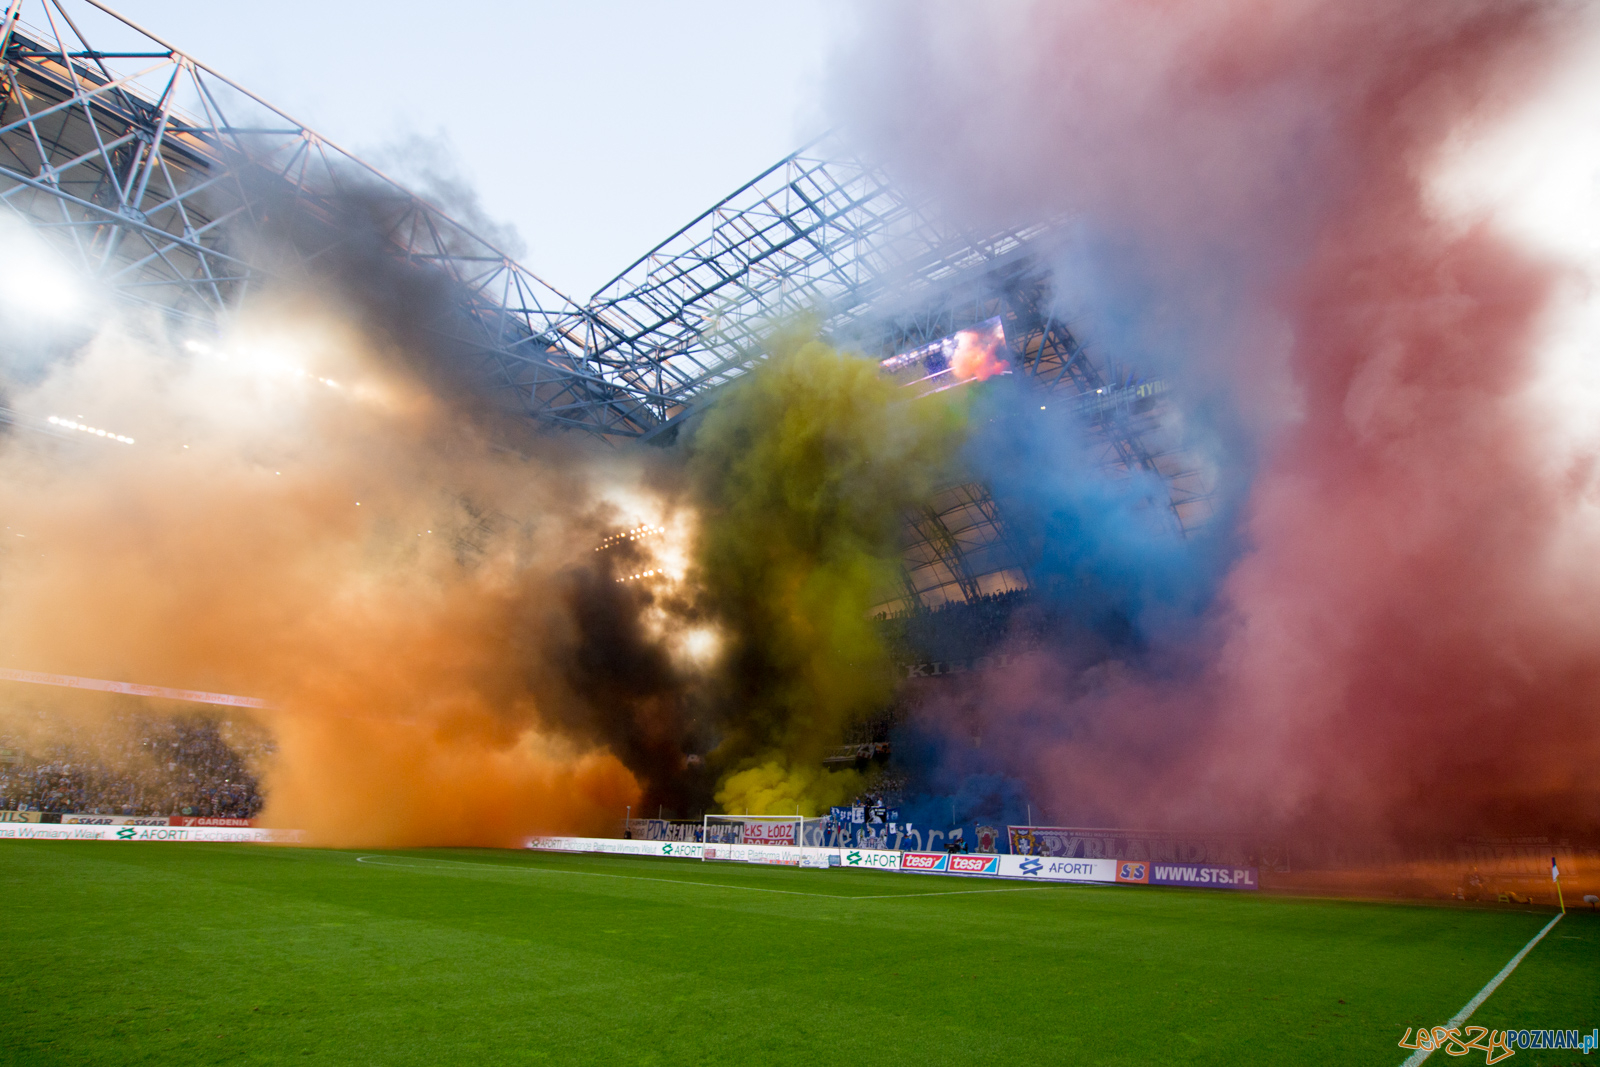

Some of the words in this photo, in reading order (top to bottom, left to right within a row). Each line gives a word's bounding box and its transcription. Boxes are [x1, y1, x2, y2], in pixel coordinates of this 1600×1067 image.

[197, 817, 249, 827] GARDENIA
[139, 829, 189, 840] AFORTI
[195, 830, 251, 842] Exchange
[744, 824, 763, 837] ŁKS
[905, 854, 932, 869] tesa
[953, 856, 982, 871] tesa
[1049, 862, 1093, 875] AFORTI
[1120, 864, 1145, 881] STS
[1154, 866, 1254, 885] WWW.STS.PL
